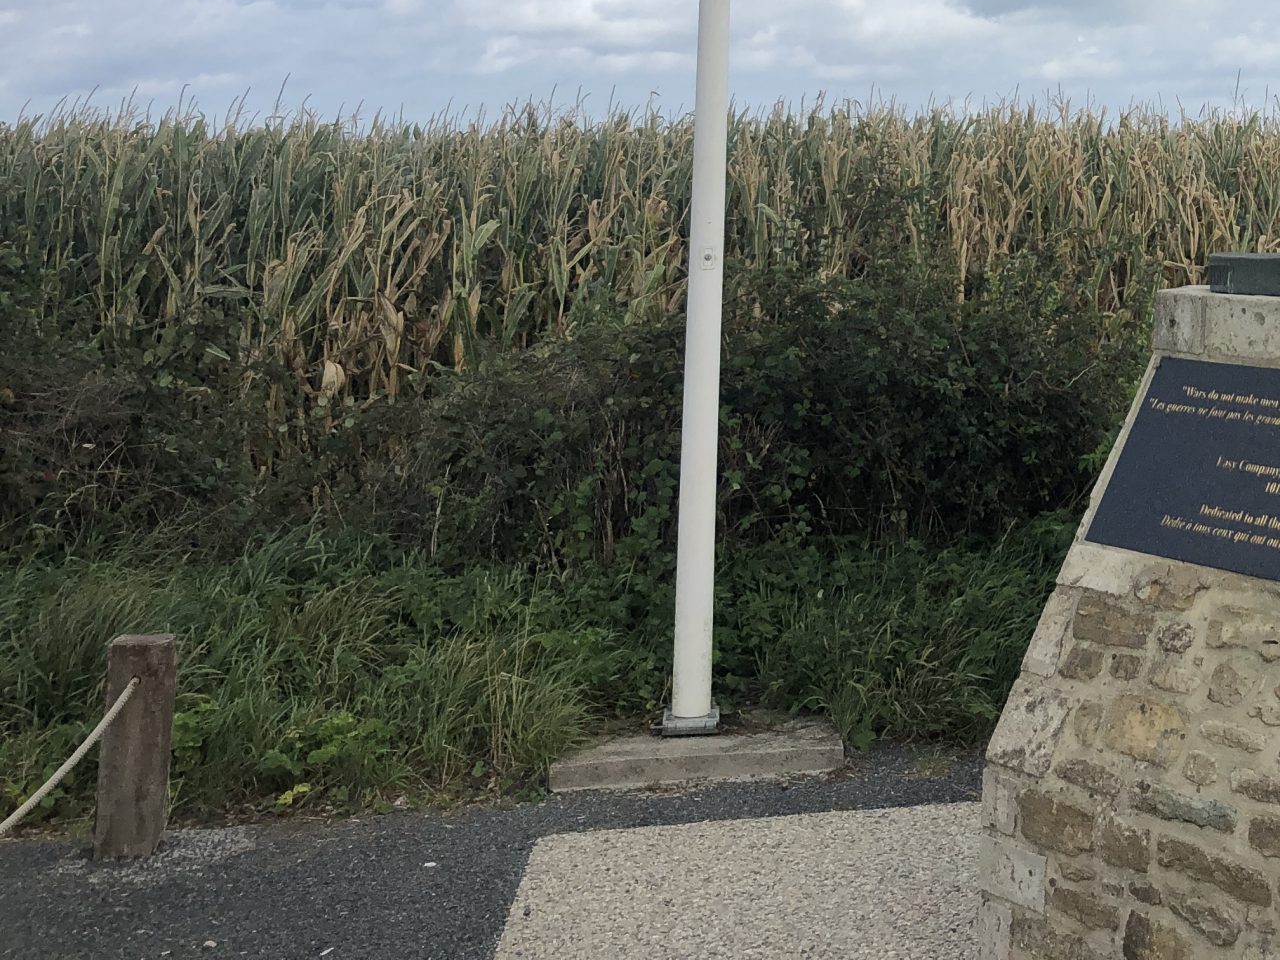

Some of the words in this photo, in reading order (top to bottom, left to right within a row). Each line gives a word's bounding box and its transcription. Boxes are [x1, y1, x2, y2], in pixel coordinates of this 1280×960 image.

[1182, 385, 1207, 399] "Wars
[1207, 389, 1219, 400] do
[1220, 392, 1234, 403] not
[1235, 393, 1259, 405] make
[1260, 398, 1279, 409] men
[1149, 397, 1166, 410] "Les
[1166, 402, 1196, 415] guerres
[1198, 406, 1209, 417] ne
[1206, 406, 1226, 420] font
[1225, 410, 1242, 422] pas
[1242, 410, 1254, 422] les
[1215, 455, 1238, 470] Easy
[1199, 503, 1244, 521] Dedicated
[1243, 513, 1254, 524] to
[1254, 514, 1269, 527] all
[1192, 522, 1212, 535] tous
[1211, 526, 1235, 539] ceux
[1233, 530, 1252, 543] qui
[1250, 534, 1268, 546] ont
